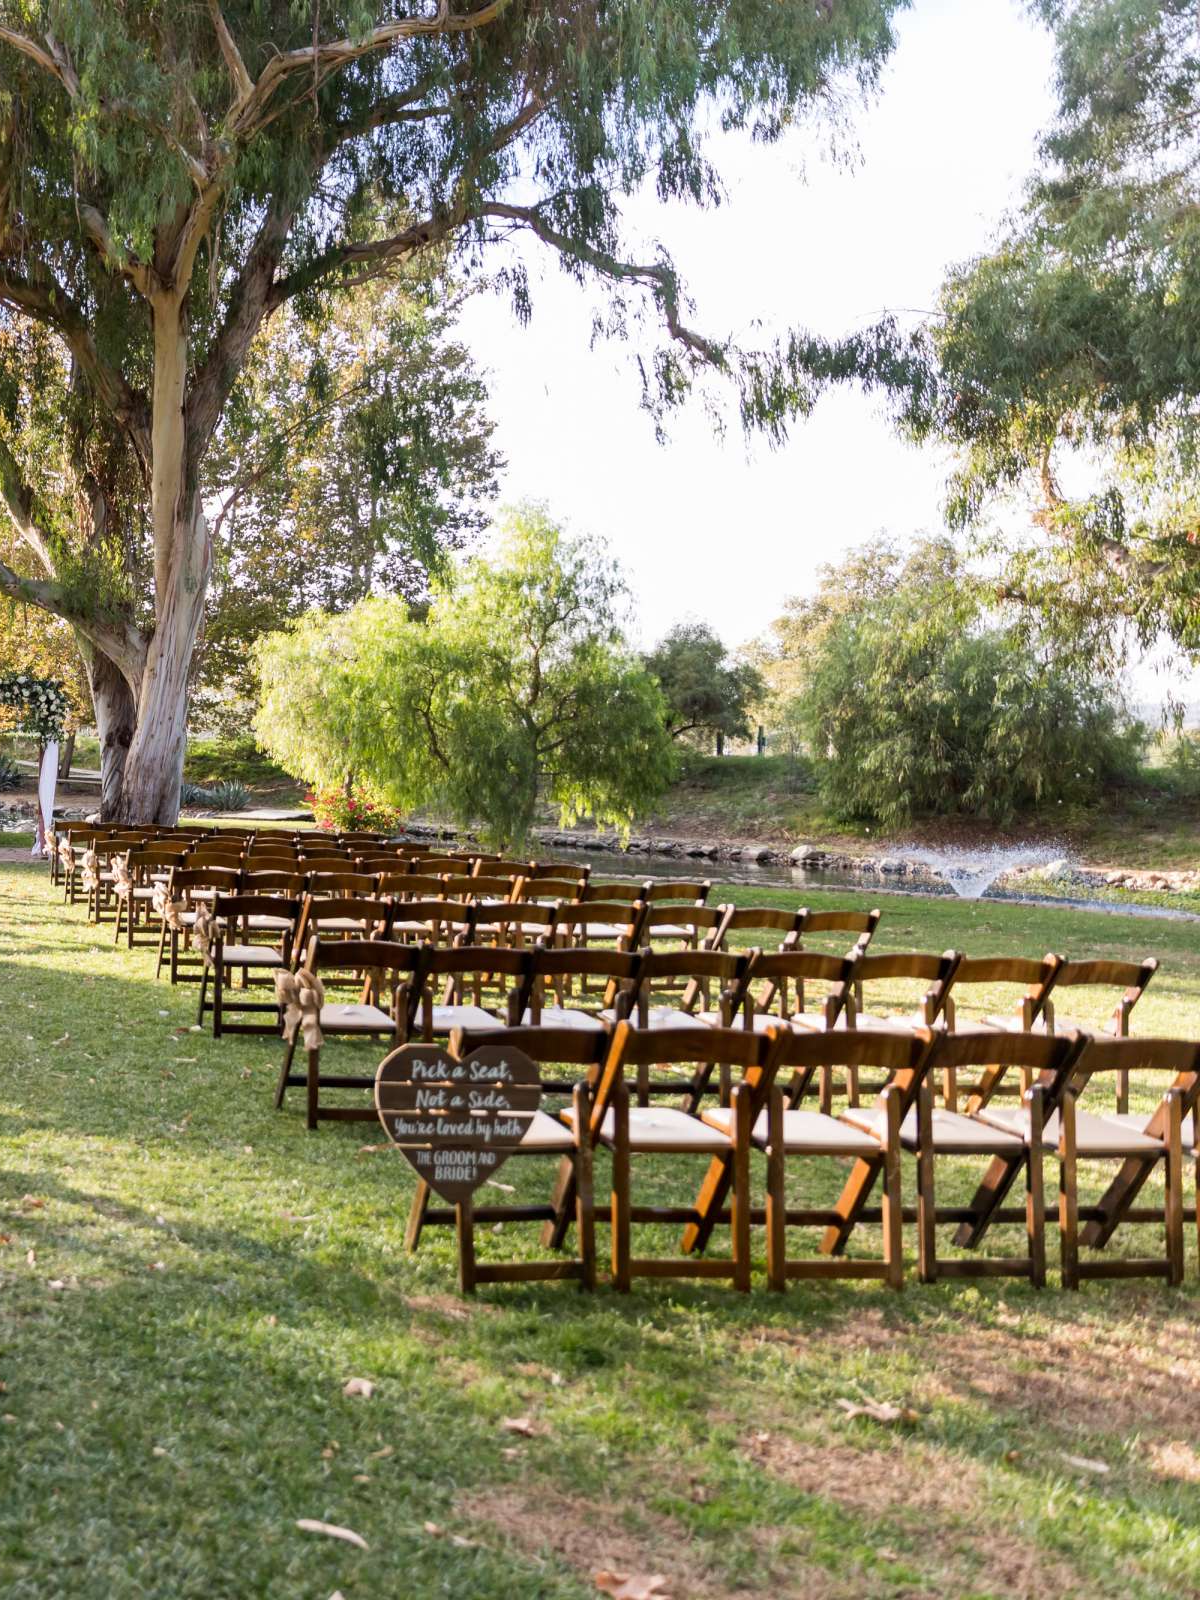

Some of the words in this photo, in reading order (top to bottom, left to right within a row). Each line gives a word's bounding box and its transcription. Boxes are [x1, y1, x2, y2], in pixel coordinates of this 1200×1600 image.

[411, 1059, 449, 1079] Pick
[451, 1065, 466, 1078] a
[468, 1060, 514, 1081] Seat,
[415, 1089, 449, 1108] Not
[450, 1093, 464, 1107] a
[468, 1089, 511, 1109] Side,
[394, 1118, 434, 1136] You're
[475, 1119, 492, 1142] by
[494, 1119, 523, 1135] both
[416, 1151, 432, 1165] THE
[433, 1150, 476, 1165] GROOM
[477, 1151, 496, 1165] AND
[434, 1165, 477, 1181] BRIDE!
